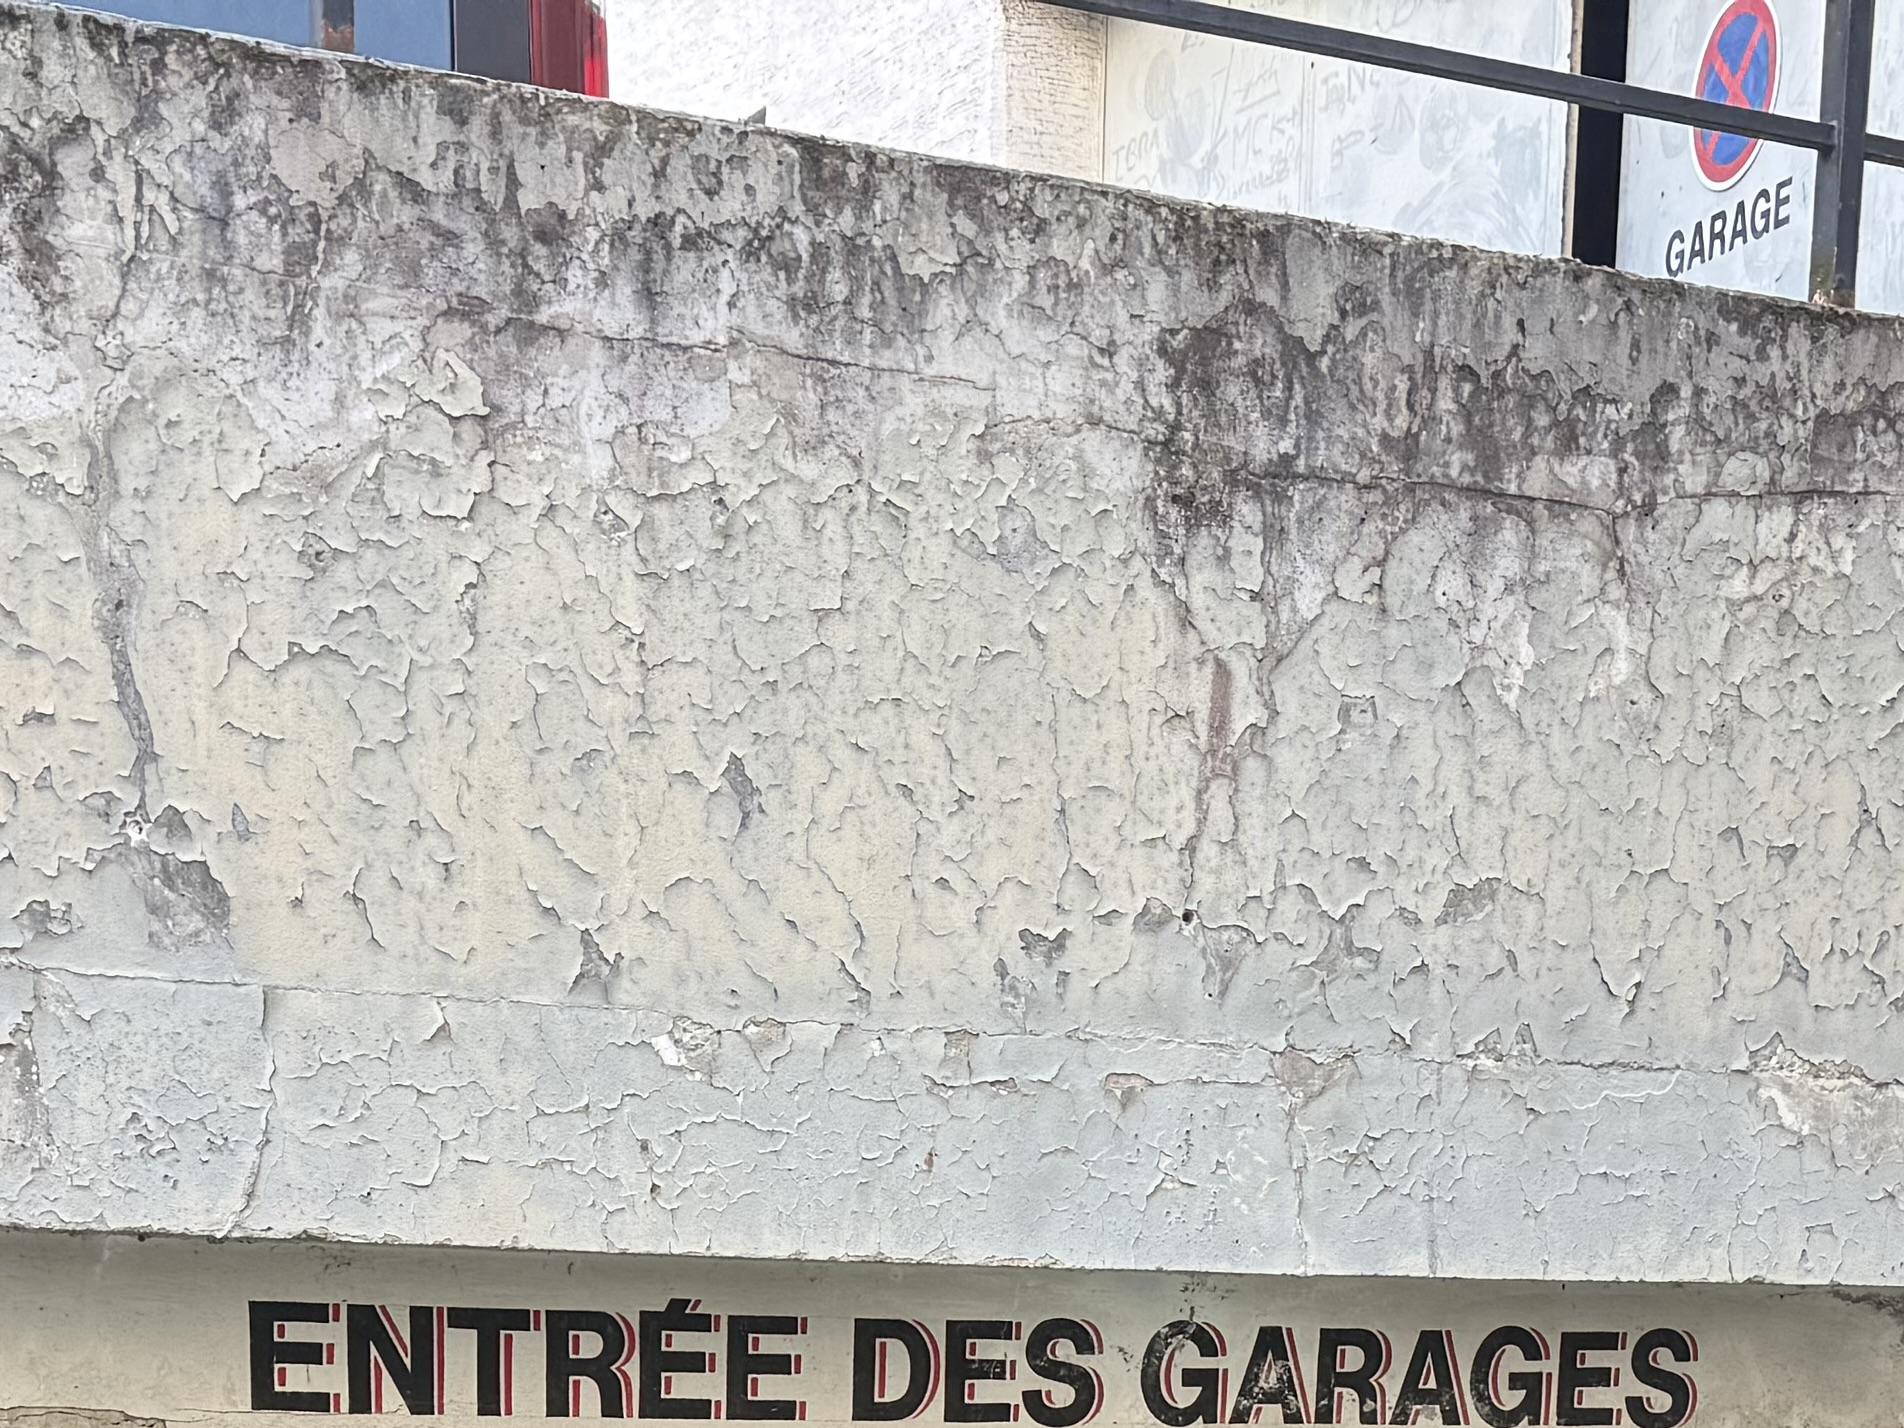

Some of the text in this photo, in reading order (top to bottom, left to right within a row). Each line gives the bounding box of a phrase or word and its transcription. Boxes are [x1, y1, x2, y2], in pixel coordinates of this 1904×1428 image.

[1666, 177, 1793, 277] GARAGE
[248, 1297, 807, 1421] ENTRÉE
[852, 1316, 1104, 1427] DES
